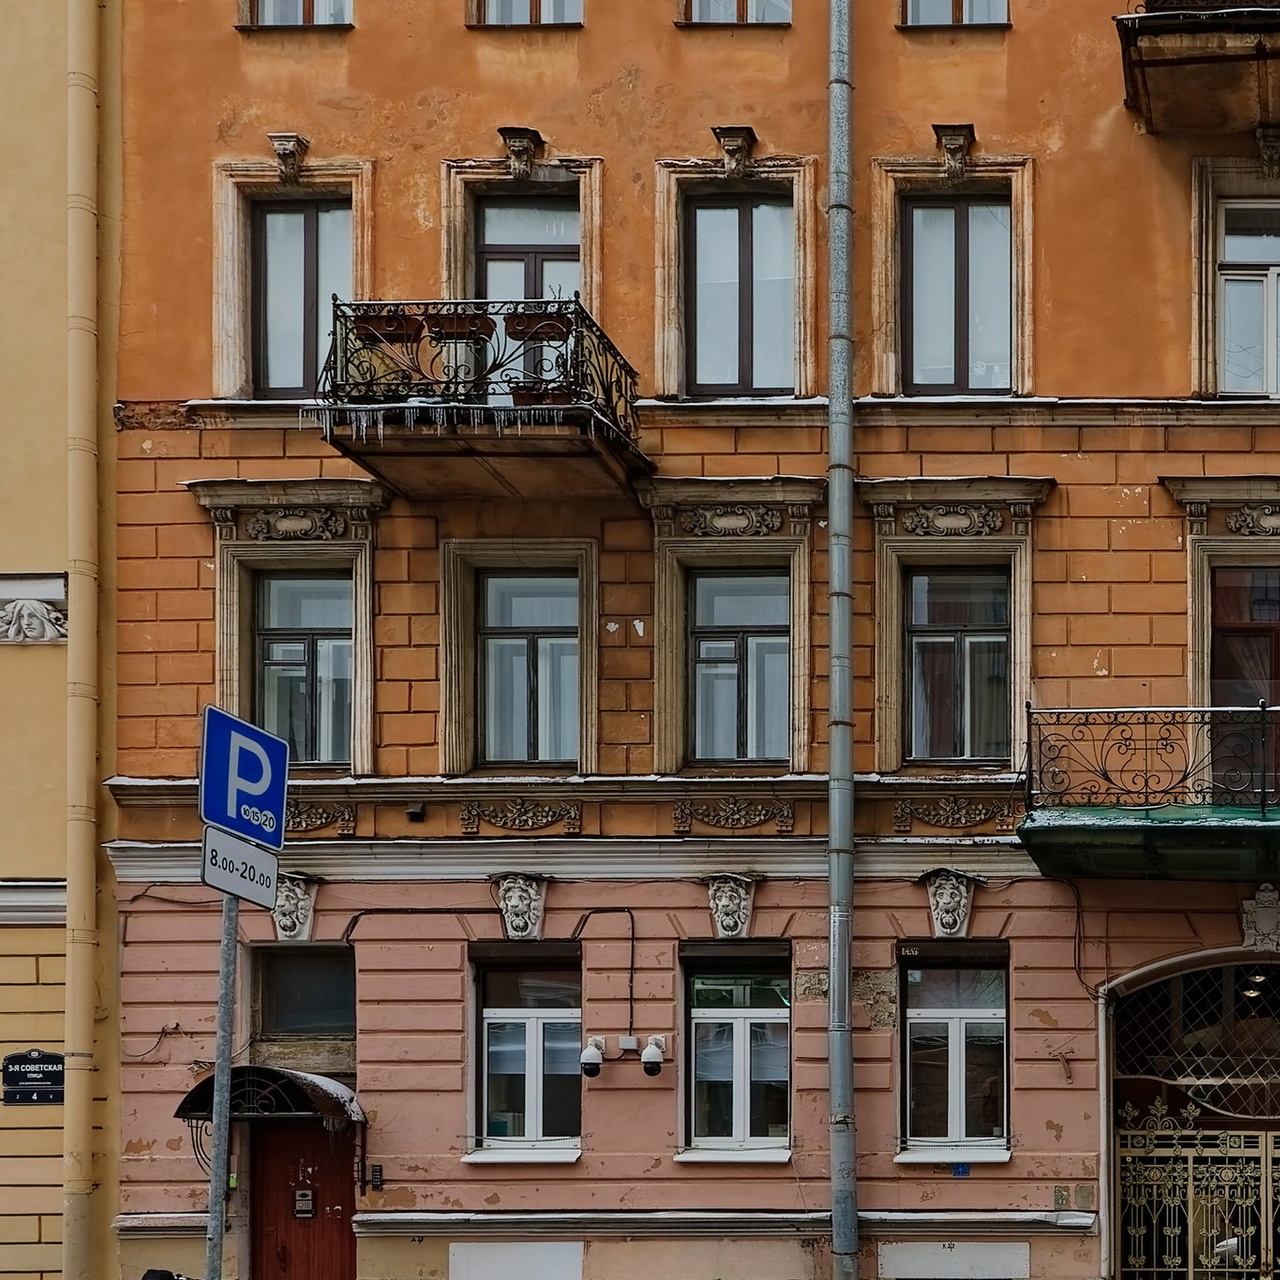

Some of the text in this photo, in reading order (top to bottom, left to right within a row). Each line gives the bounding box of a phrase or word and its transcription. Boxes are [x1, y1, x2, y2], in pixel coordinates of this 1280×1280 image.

[227, 730, 272, 819] P
[242, 807, 274, 829] 10 15 20
[209, 848, 272, 889] 8.00-20.00
[20, 1064, 63, 1072] СОВЕТСКАЯ
[31, 1092, 38, 1100] 4
